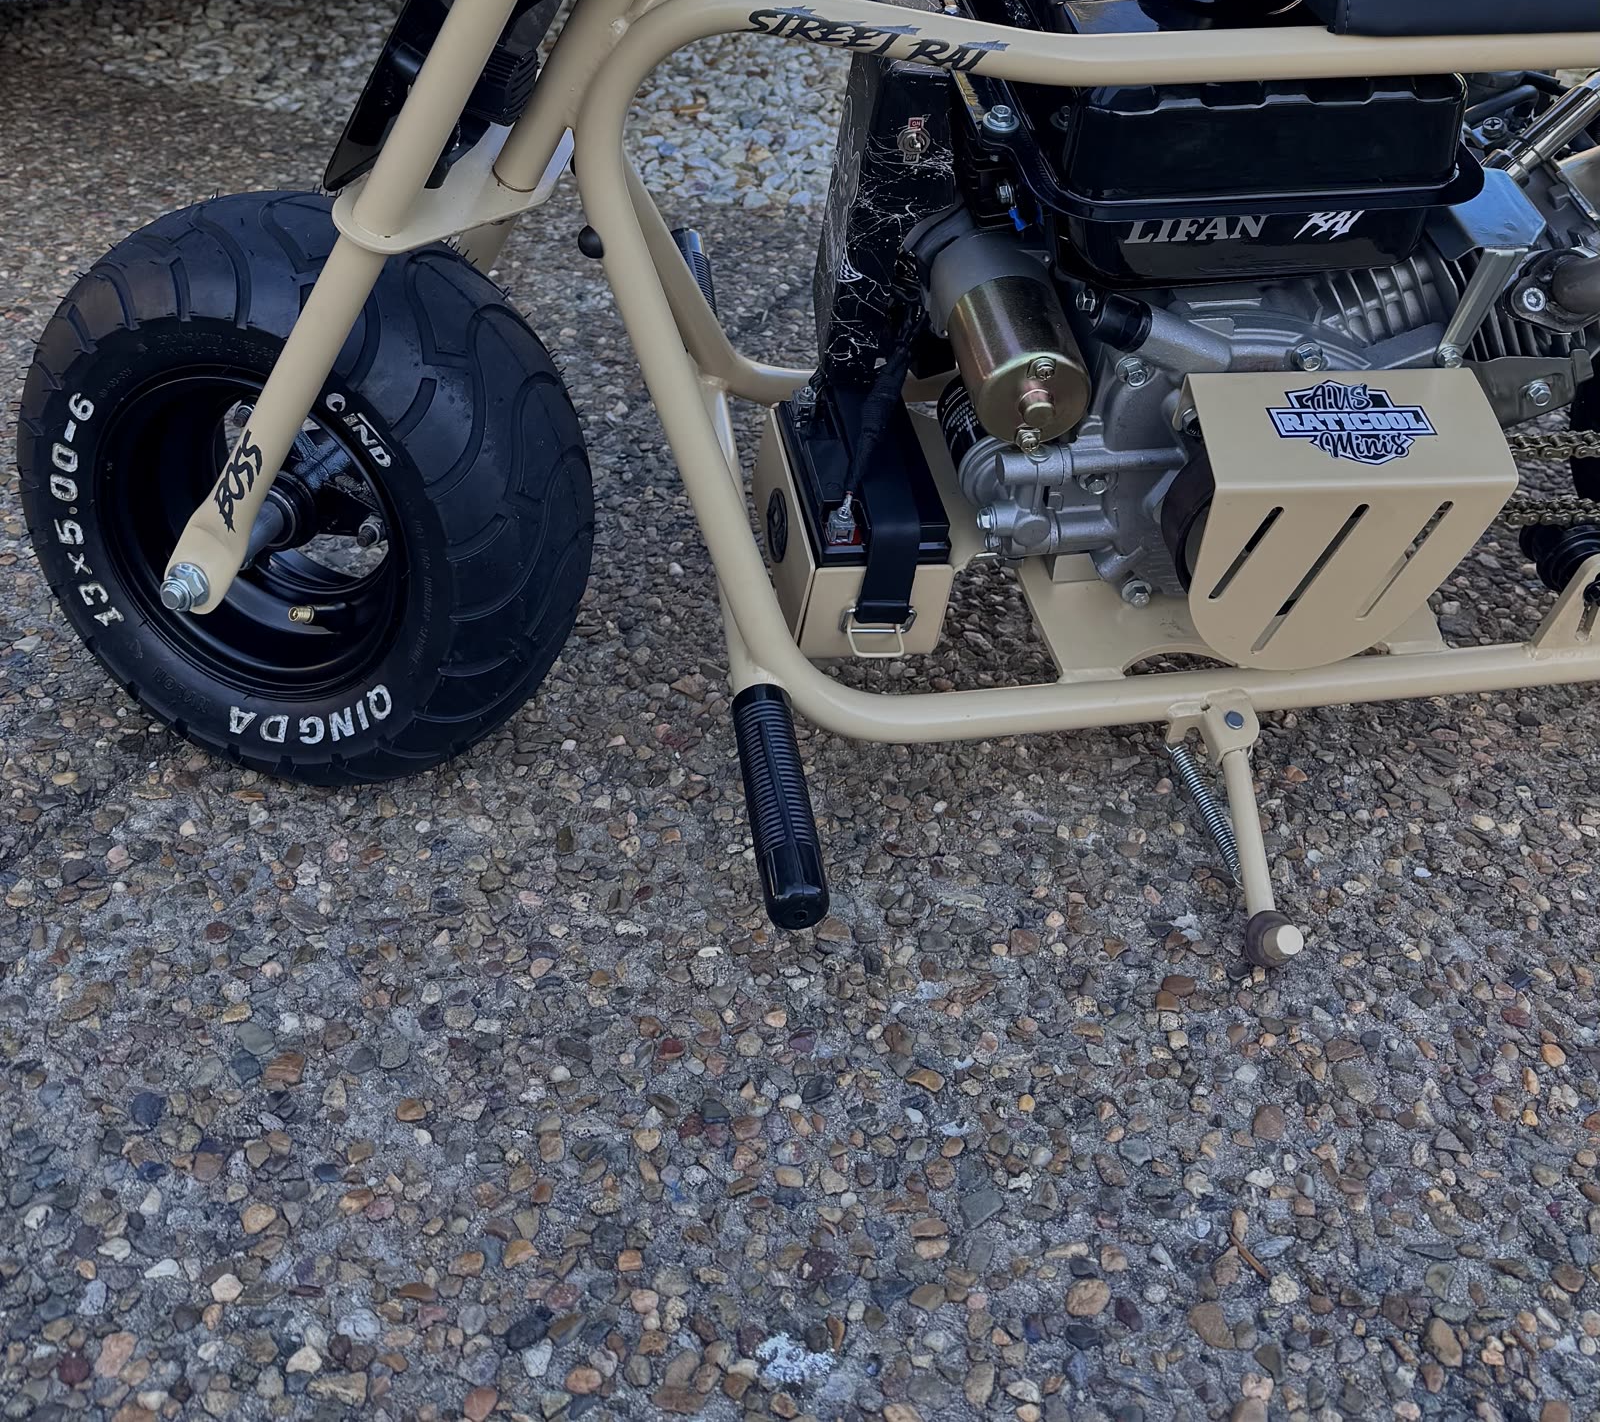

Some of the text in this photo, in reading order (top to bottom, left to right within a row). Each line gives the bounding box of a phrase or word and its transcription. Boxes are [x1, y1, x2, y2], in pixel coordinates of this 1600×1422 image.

[748, 5, 1010, 71] STREET RAT
[1124, 210, 1366, 244] LIFAN RAT
[1304, 383, 1373, 410] AUS
[1278, 412, 1427, 431] RATICOOL
[1319, 431, 1409, 459] Minis
[214, 429, 262, 533] BOSS
[229, 684, 392, 744] QINGDA
